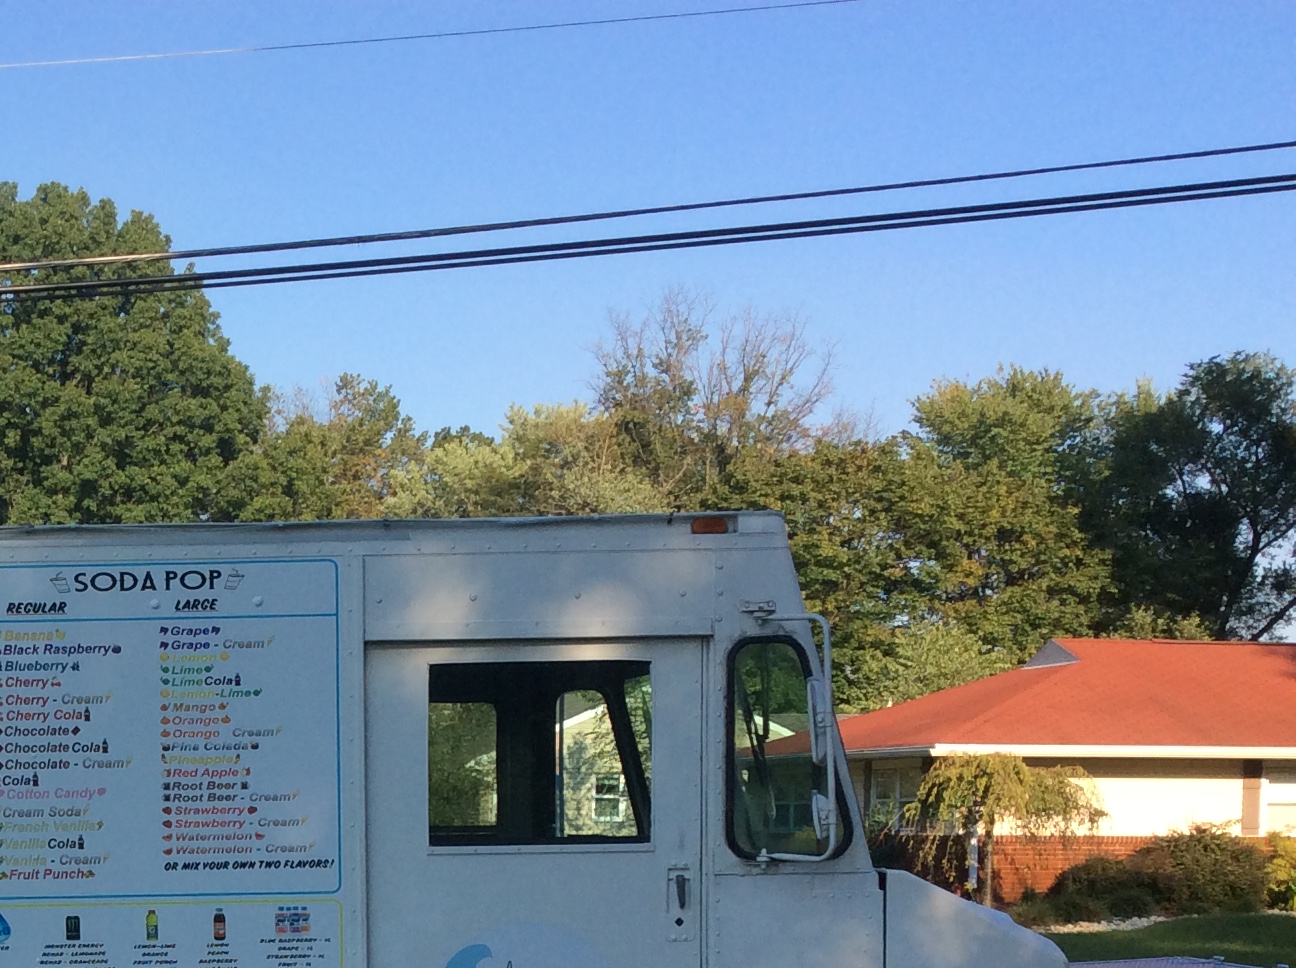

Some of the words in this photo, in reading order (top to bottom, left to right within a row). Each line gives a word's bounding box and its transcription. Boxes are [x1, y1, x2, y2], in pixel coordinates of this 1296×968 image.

[73, 571, 157, 592] SODA
[164, 570, 222, 591] POP
[6, 601, 67, 614] REGULAR
[175, 598, 218, 612] LARGE
[4, 630, 54, 642] Banana
[171, 626, 210, 636] Grape
[3, 644, 39, 655] Black
[43, 643, 111, 657] Raspberry
[171, 641, 210, 651] Grape
[223, 639, 265, 649] Cream
[4, 661, 69, 673] Blueberry
[171, 665, 203, 674] Lime
[5, 677, 49, 690] Cherry
[204, 676, 233, 686] Cola
[6, 694, 49, 707] Cherry
[61, 693, 104, 705] Cream
[172, 702, 216, 713] Mango
[6, 710, 49, 723] Cherry
[54, 709, 83, 720] Cola
[172, 716, 220, 726] Orange
[4, 726, 70, 737] Chocolate
[173, 729, 220, 740] Orange
[232, 728, 275, 738] Cream
[5, 742, 70, 753] Chocolate
[72, 742, 101, 753] Cola
[5, 758, 70, 770] Chocolate
[82, 757, 125, 769] Cream
[172, 768, 198, 777] Red
[201, 768, 239, 779] Apple
[2, 775, 31, 786] Cola
[172, 782, 203, 791] Root
[207, 781, 238, 790] Beer
[7, 788, 50, 800] Cotton
[54, 787, 96, 800] Candy
[172, 794, 204, 803] Root
[207, 793, 238, 802] Beer
[249, 793, 291, 802] Cream
[3, 806, 45, 818] Cream
[48, 806, 83, 817] Soda
[174, 806, 246, 816] Strawberry
[175, 819, 246, 829] Strawberry
[258, 818, 300, 827] Cream
[175, 832, 252, 842] Watermelon
[48, 838, 76, 849] Cola
[176, 845, 253, 855] Watermelon
[265, 844, 307, 853] Cream
[59, 854, 102, 865] Cream
[164, 862, 179, 871] OR
[181, 862, 200, 870] MIX
[203, 861, 230, 870] YOUR
[232, 861, 256, 869] OWN
[258, 860, 281, 869] TWO
[283, 859, 335, 869] FLAVORS!
[9, 869, 40, 880] Fruit
[43, 868, 84, 879] Punch
